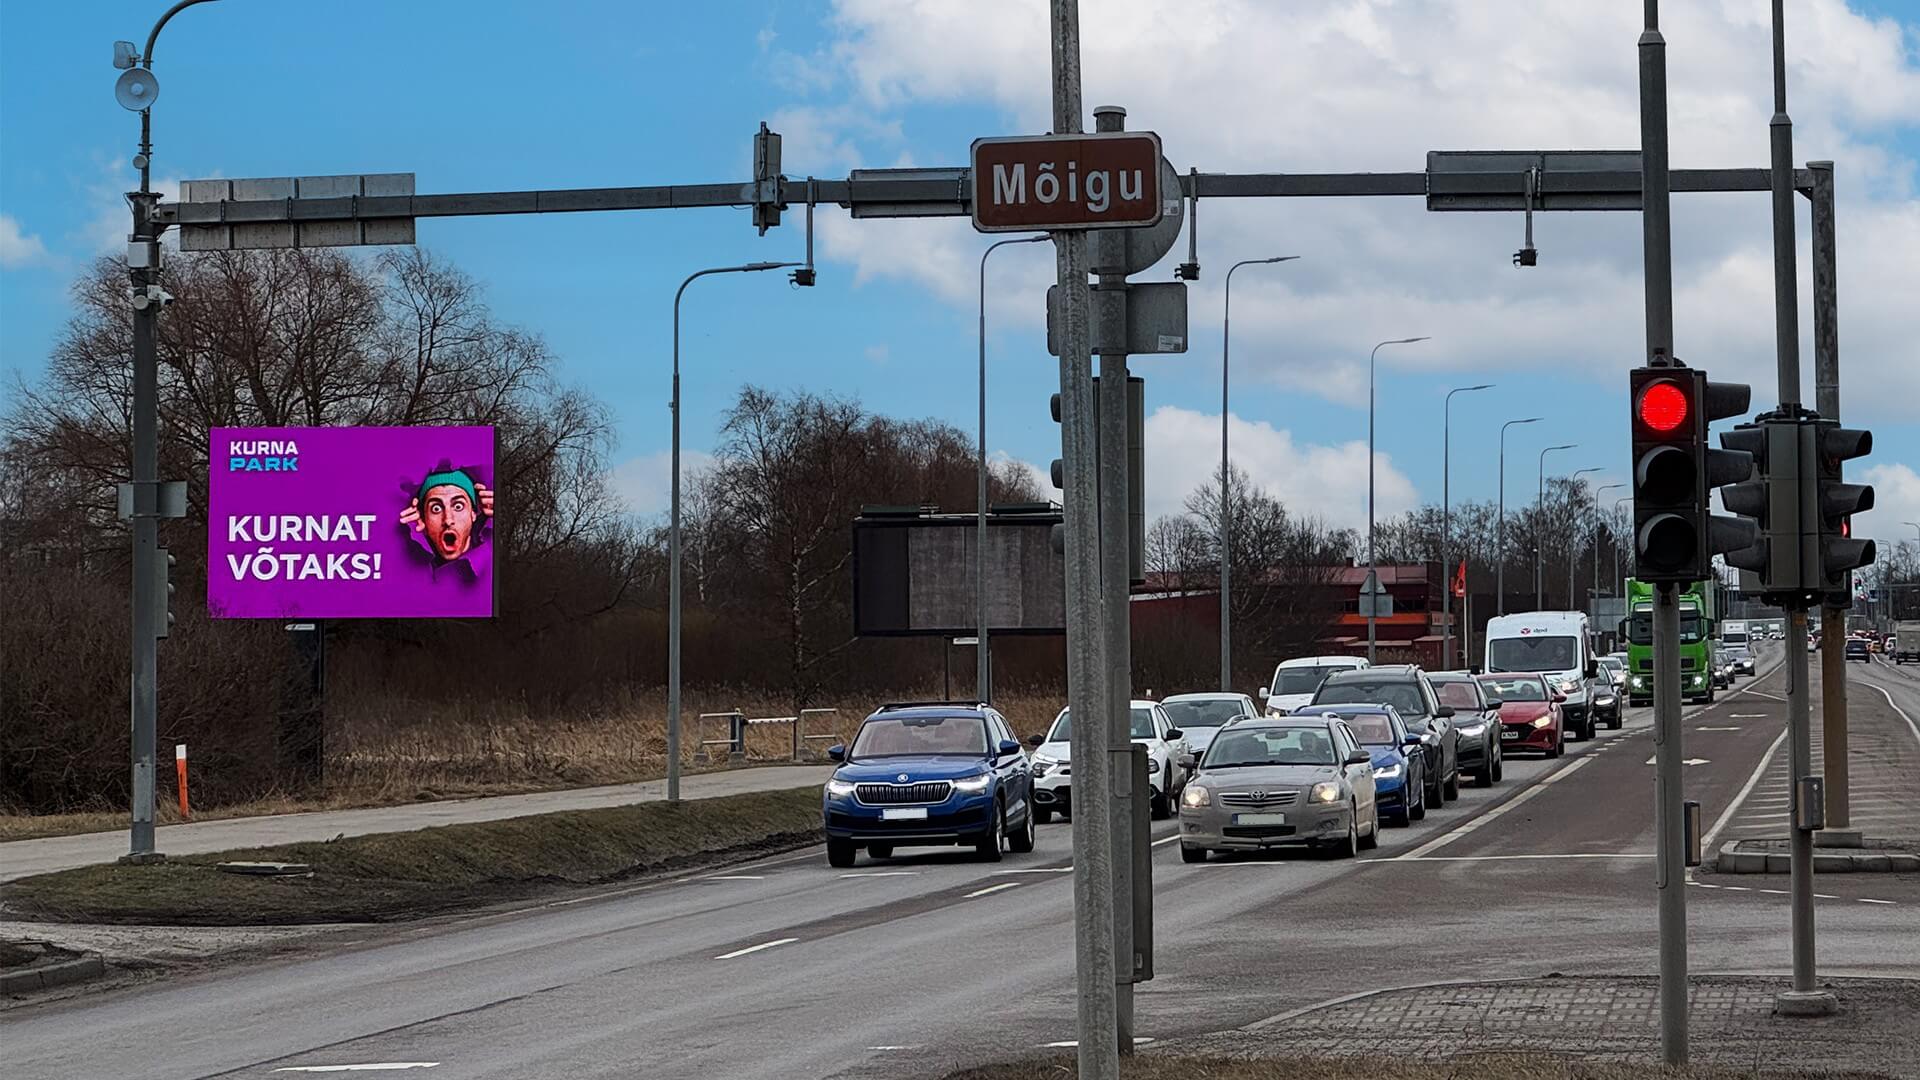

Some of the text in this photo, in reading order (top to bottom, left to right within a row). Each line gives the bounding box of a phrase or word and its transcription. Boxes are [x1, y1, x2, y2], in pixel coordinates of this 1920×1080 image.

[993, 161, 1143, 213] Mõigu
[230, 440, 299, 456] KURNA
[229, 457, 298, 472] PARK
[228, 514, 377, 542] KURNAT
[227, 546, 382, 581] VÕTAKS!
